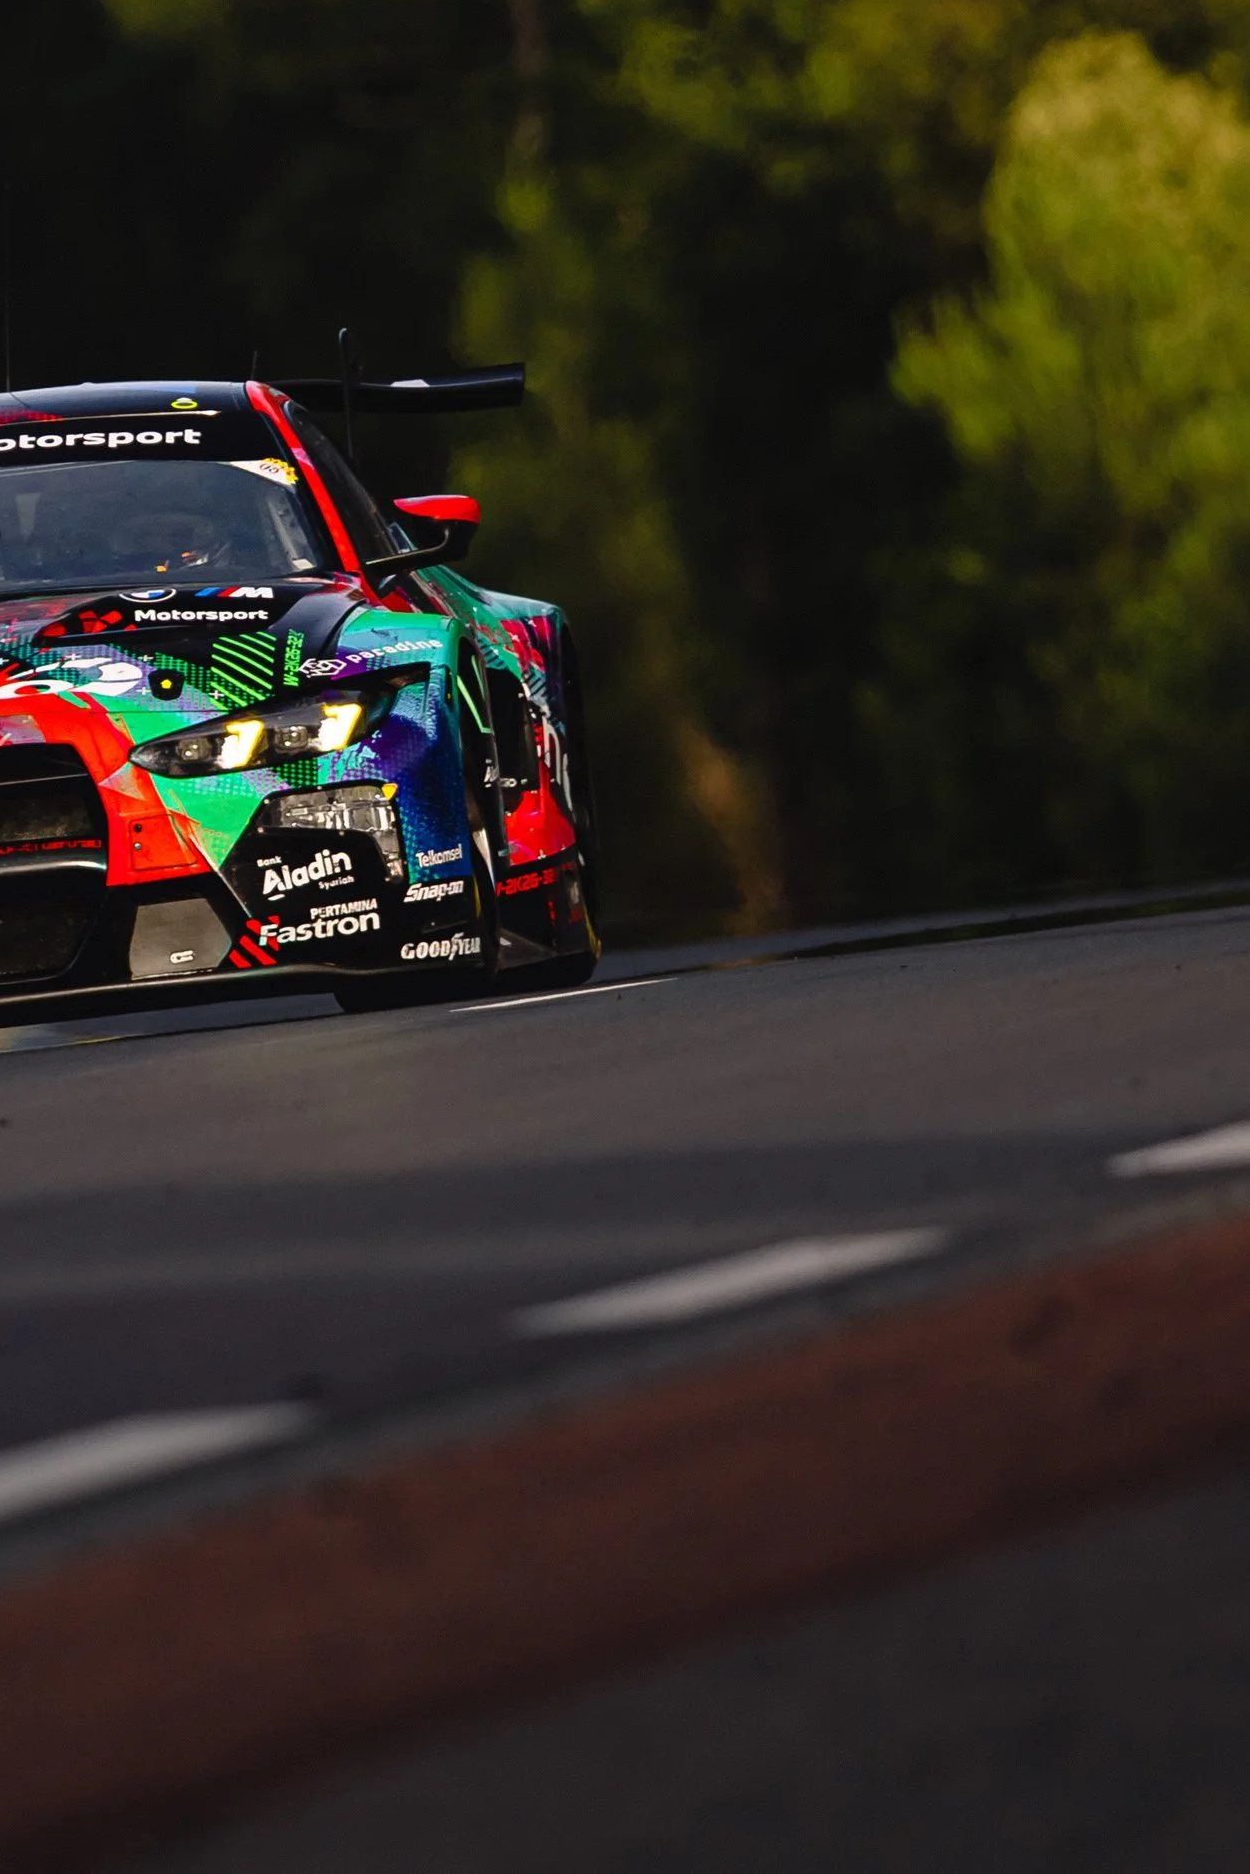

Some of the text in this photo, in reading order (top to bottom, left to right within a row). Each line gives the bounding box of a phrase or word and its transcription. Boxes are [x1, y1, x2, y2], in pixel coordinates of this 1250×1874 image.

[134, 608, 269, 622] Motorsport
[345, 638, 444, 664] paradine
[256, 855, 282, 868] Bank
[415, 843, 463, 868] Telkomsel
[262, 849, 352, 896] Aladin
[318, 875, 355, 890] Syariah
[403, 879, 465, 903] Snap-on
[309, 898, 378, 919] PERTAMINA
[258, 912, 381, 946] Fastron
[400, 932, 481, 960] GOODYEAR
